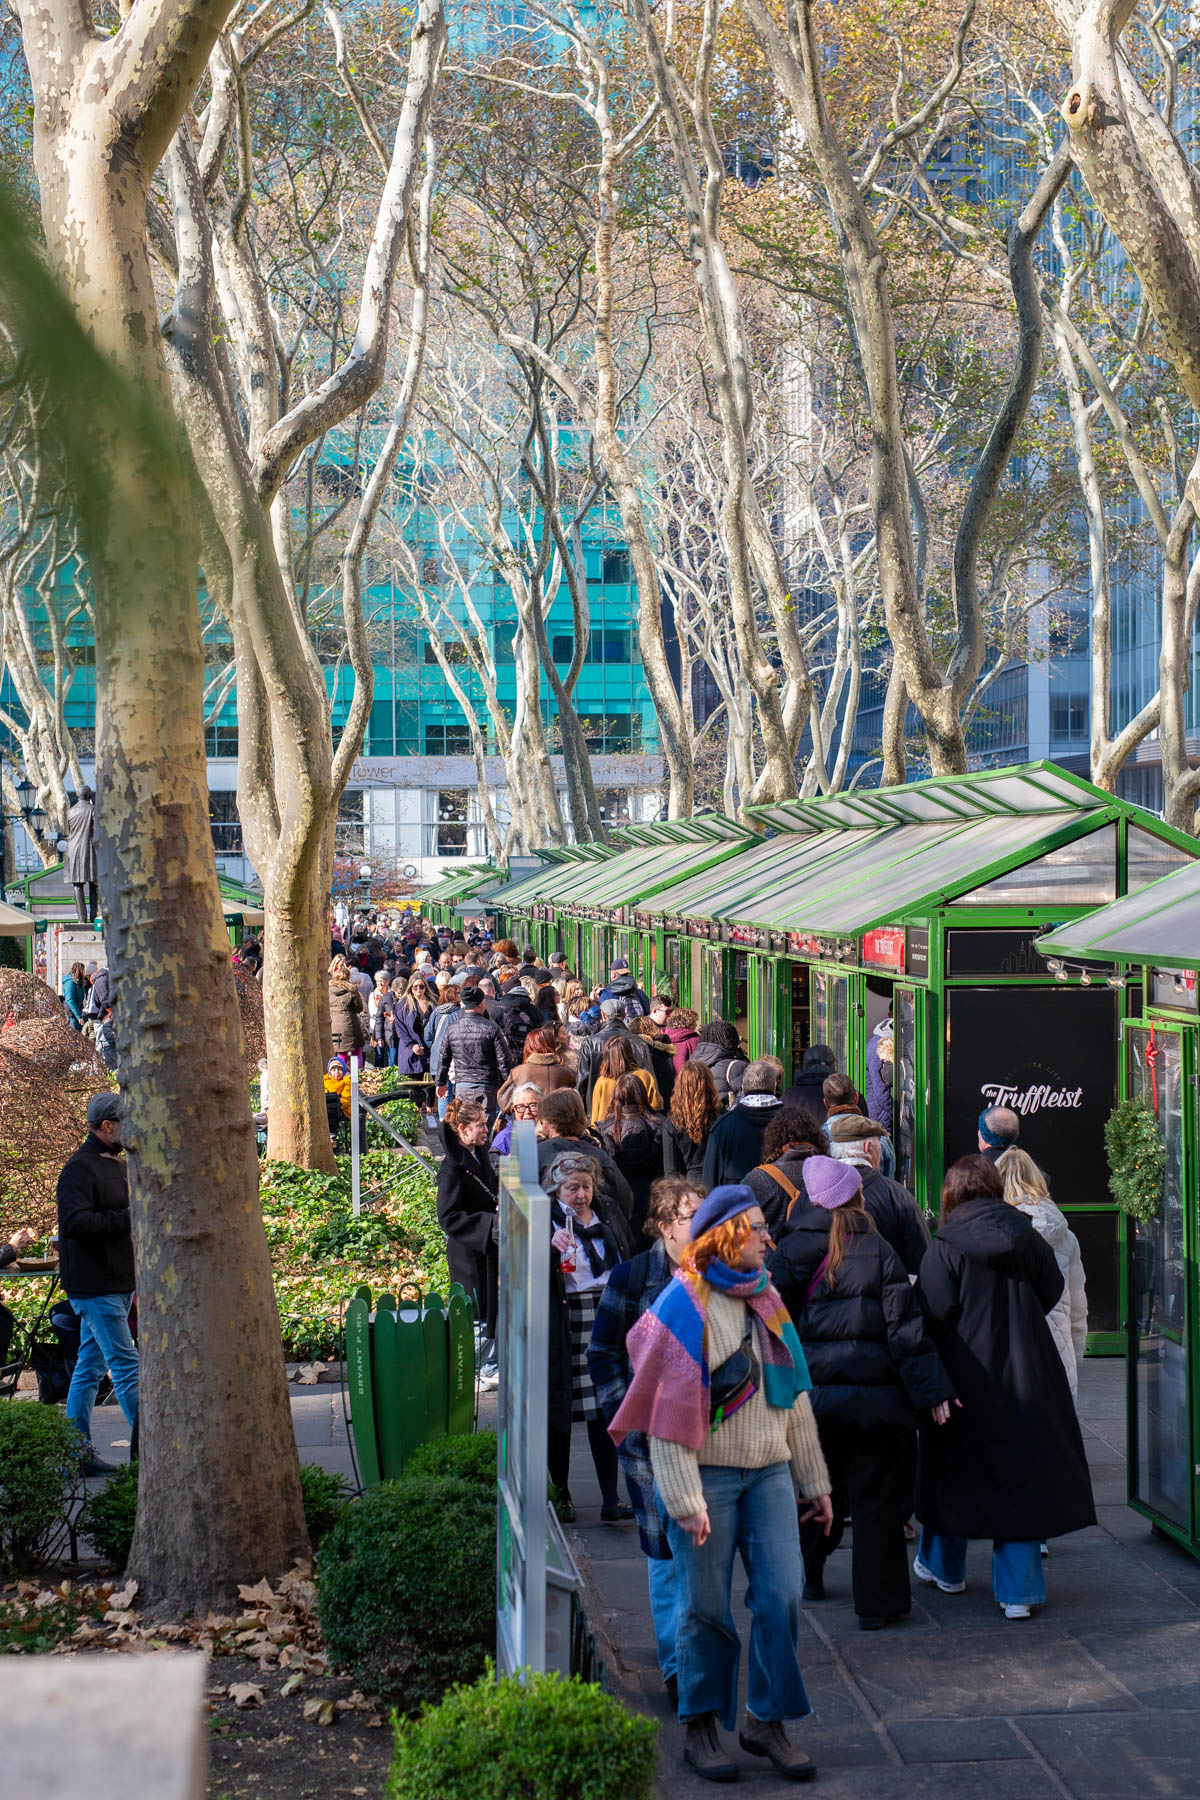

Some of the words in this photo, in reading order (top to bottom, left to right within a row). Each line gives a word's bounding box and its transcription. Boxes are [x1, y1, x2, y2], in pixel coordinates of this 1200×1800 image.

[352, 763, 396, 778] Tower
[981, 1083, 1083, 1115] Truffleist
[985, 1089, 998, 1098] the
[356, 1347, 364, 1395] BRYANT
